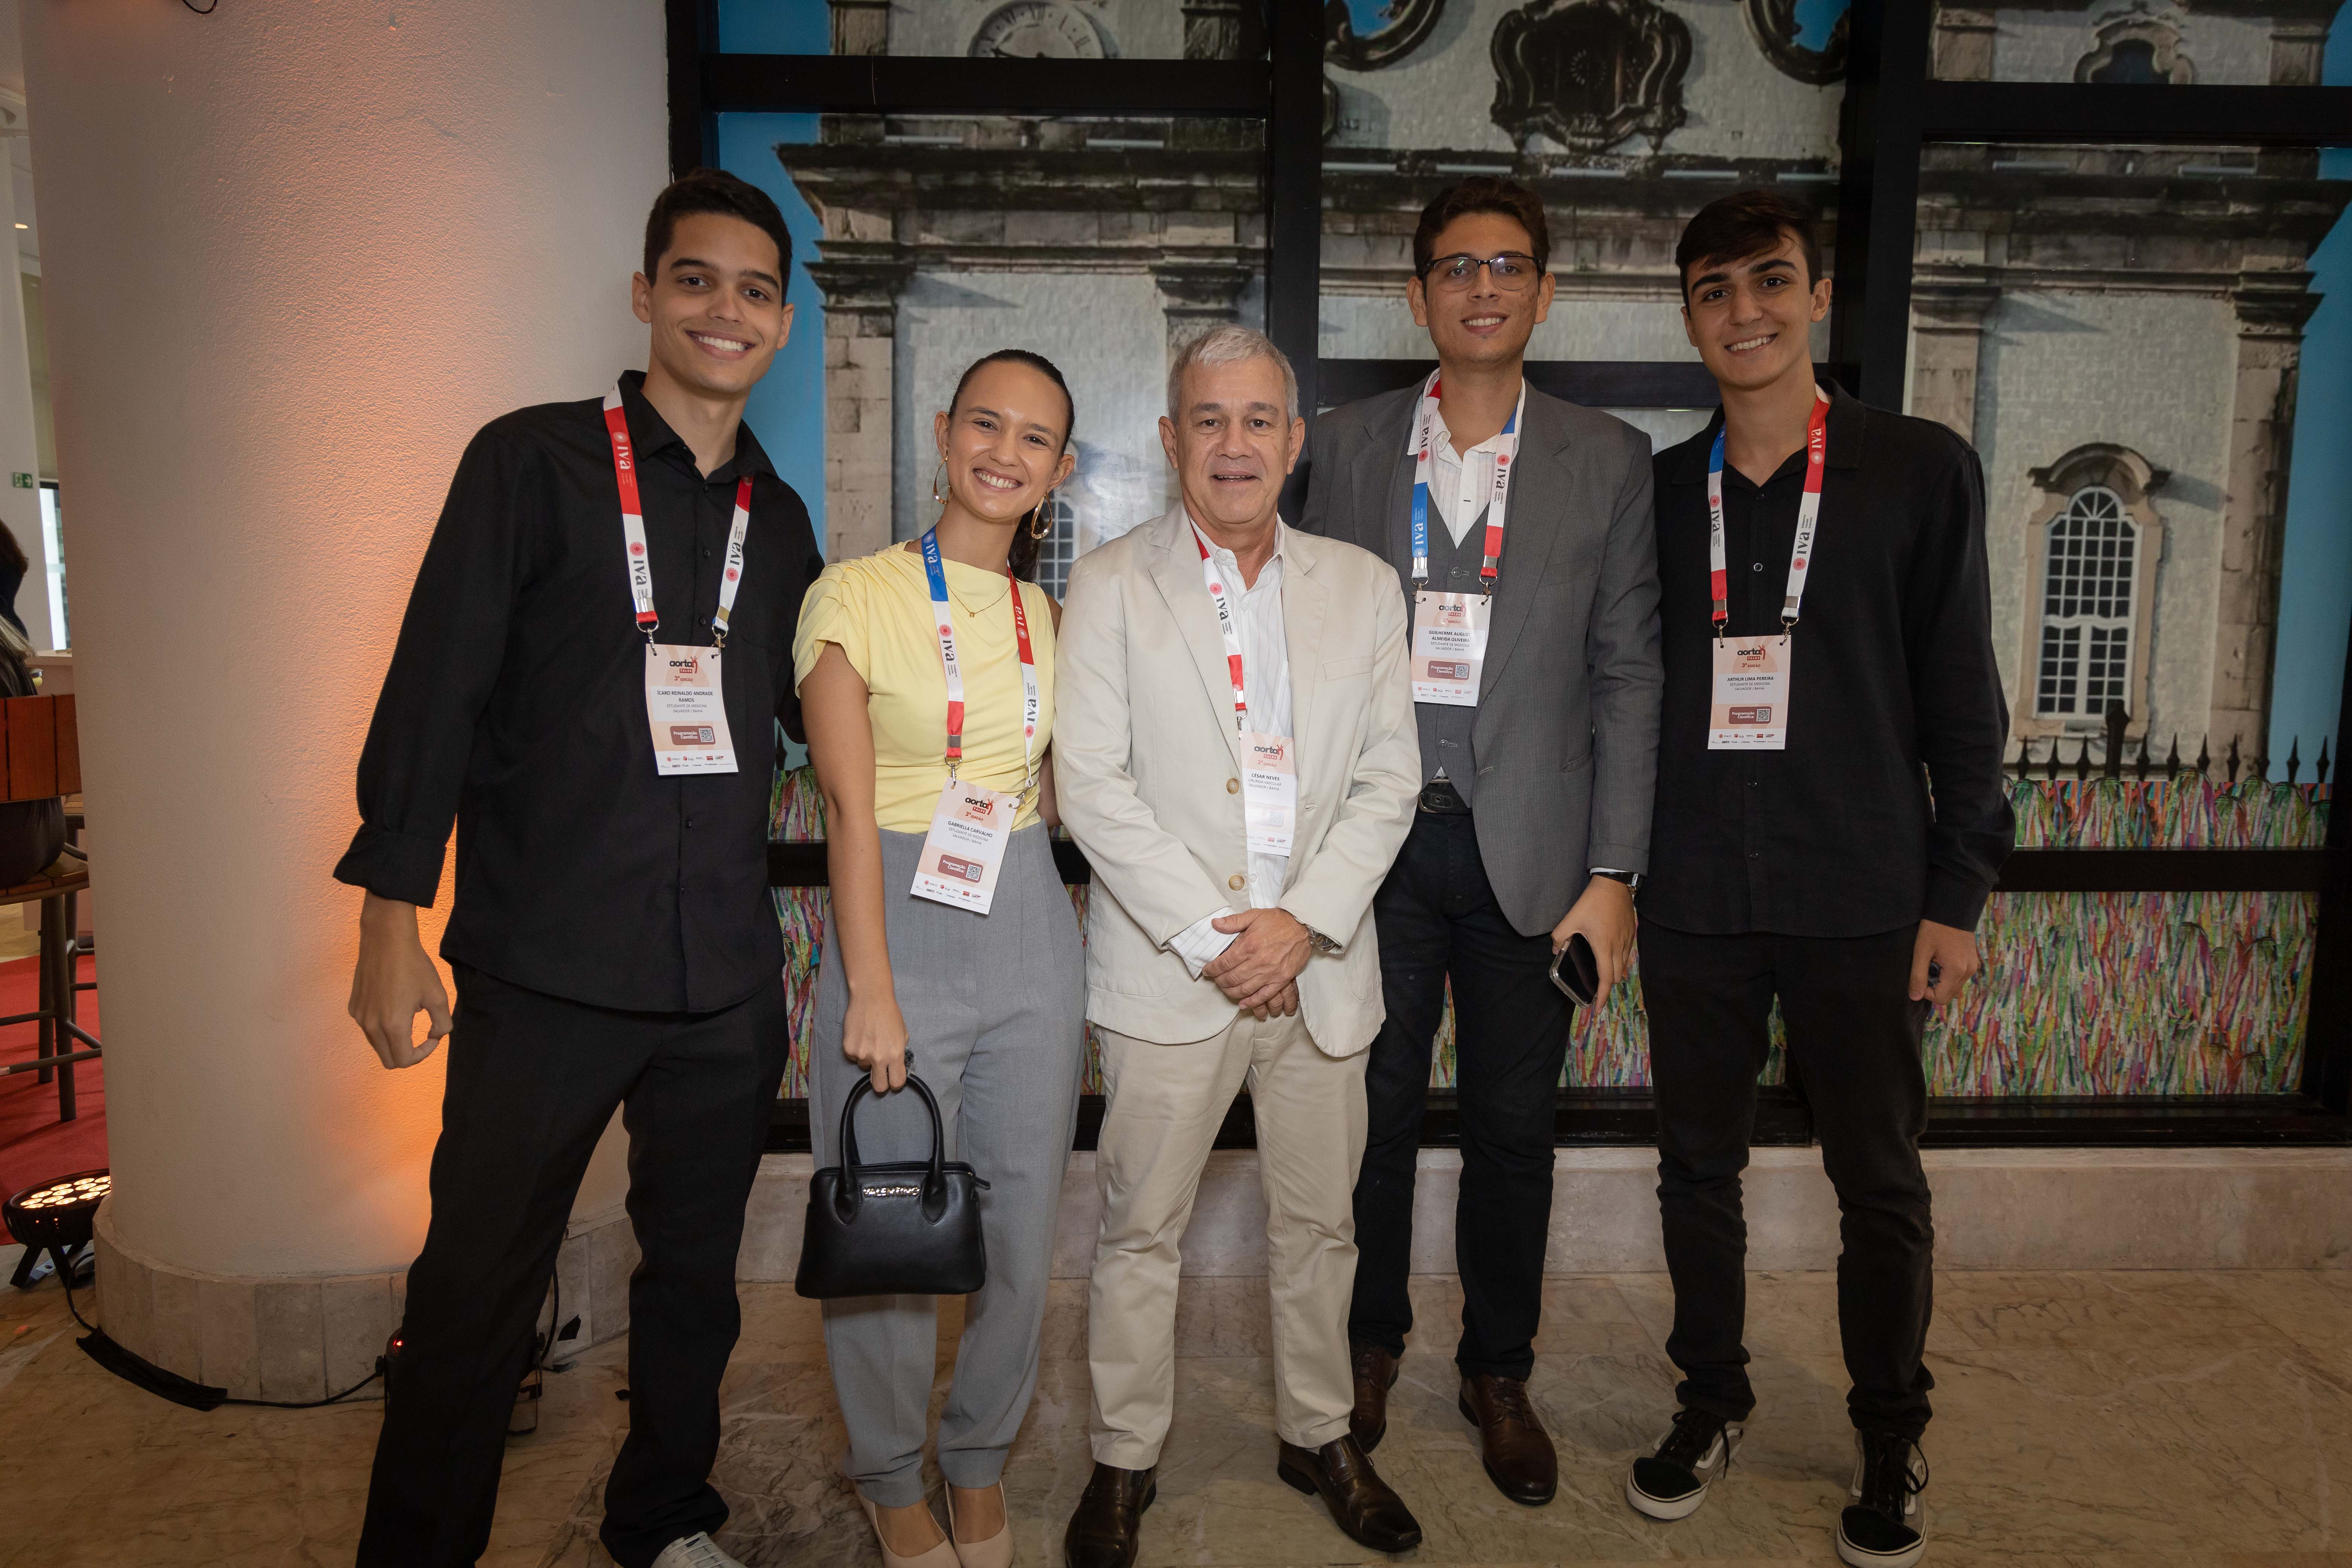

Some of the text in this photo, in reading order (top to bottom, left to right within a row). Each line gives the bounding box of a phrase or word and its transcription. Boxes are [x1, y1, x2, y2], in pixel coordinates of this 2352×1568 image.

[965, 798, 988, 808] aorta
[948, 821, 992, 838] GABRIELLA CARVALHO
[943, 860, 966, 870] Programação
